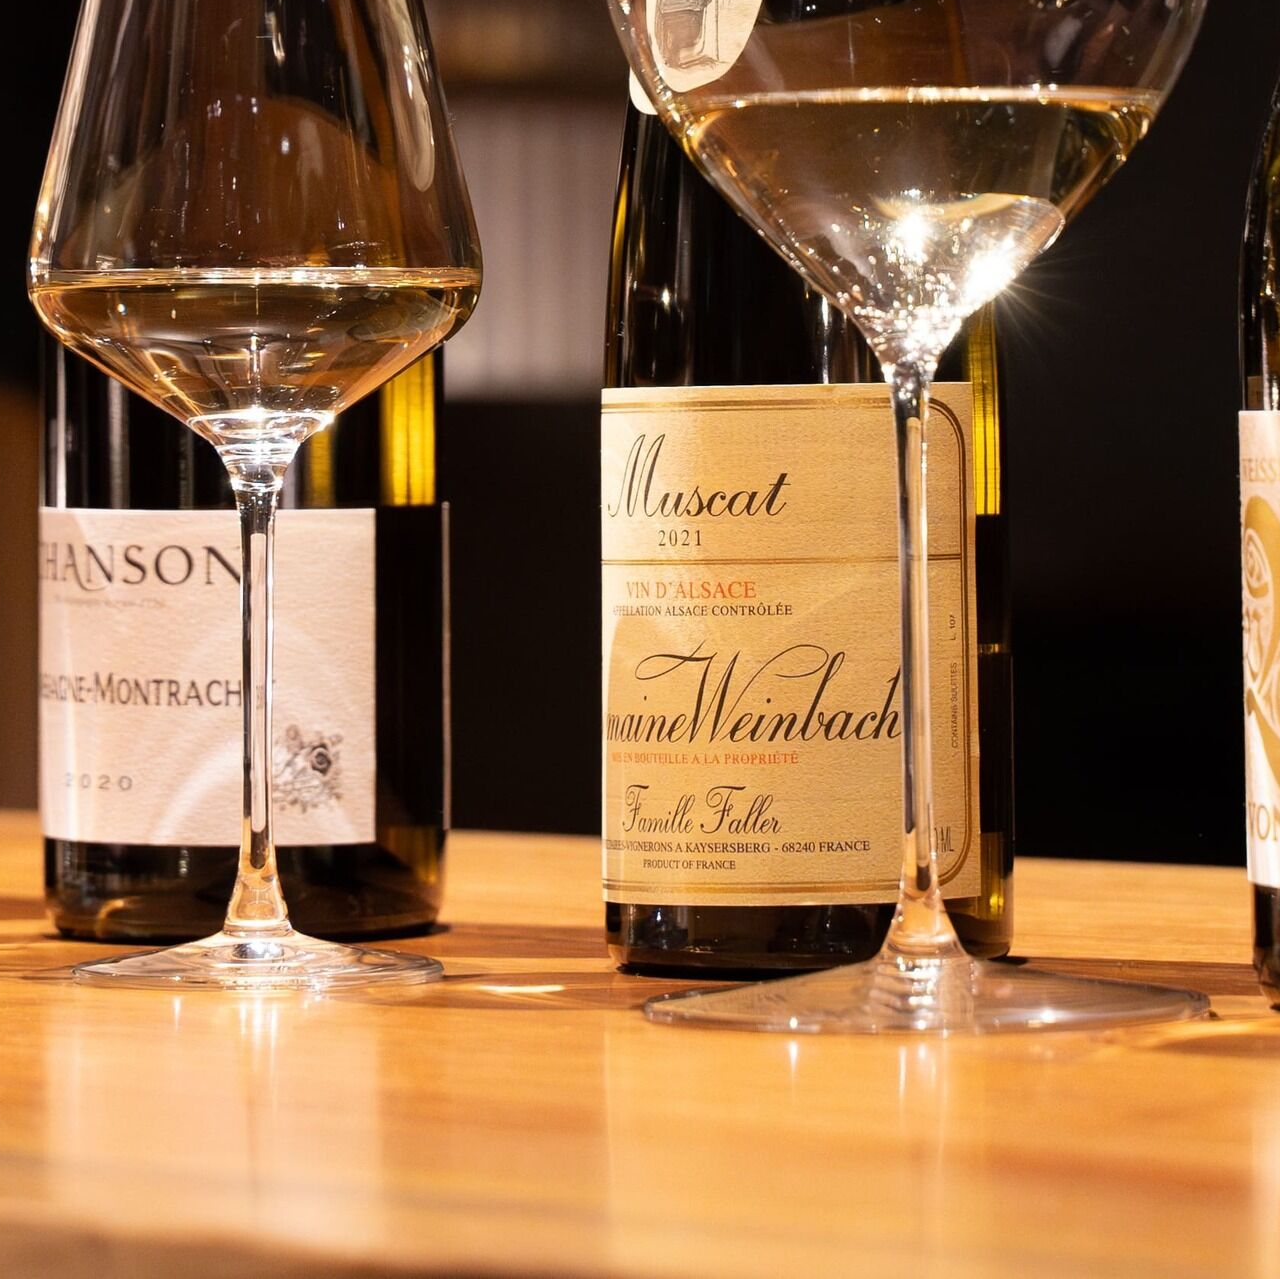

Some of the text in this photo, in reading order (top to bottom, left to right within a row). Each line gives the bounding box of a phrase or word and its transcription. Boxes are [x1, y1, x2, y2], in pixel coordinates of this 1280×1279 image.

[608, 433, 791, 518] Muscat
[658, 529, 703, 547] 2021
[626, 581, 757, 599] VIN D'ALSACE
[664, 604, 708, 617] ALSACE
[711, 601, 793, 617] CONTRÔLÉE
[635, 639, 902, 745] Weinbach
[634, 751, 688, 765] BOUTEILLE
[704, 752, 720, 765] LA
[724, 749, 799, 765] PROPRIÉTÉ
[622, 784, 783, 835] Famille Faller
[685, 841, 770, 854] KAYSERSBERG
[781, 840, 816, 854] 68240
[819, 839, 871, 852] FRANCE
[643, 858, 737, 871] PRODUCT OF FRANCE
